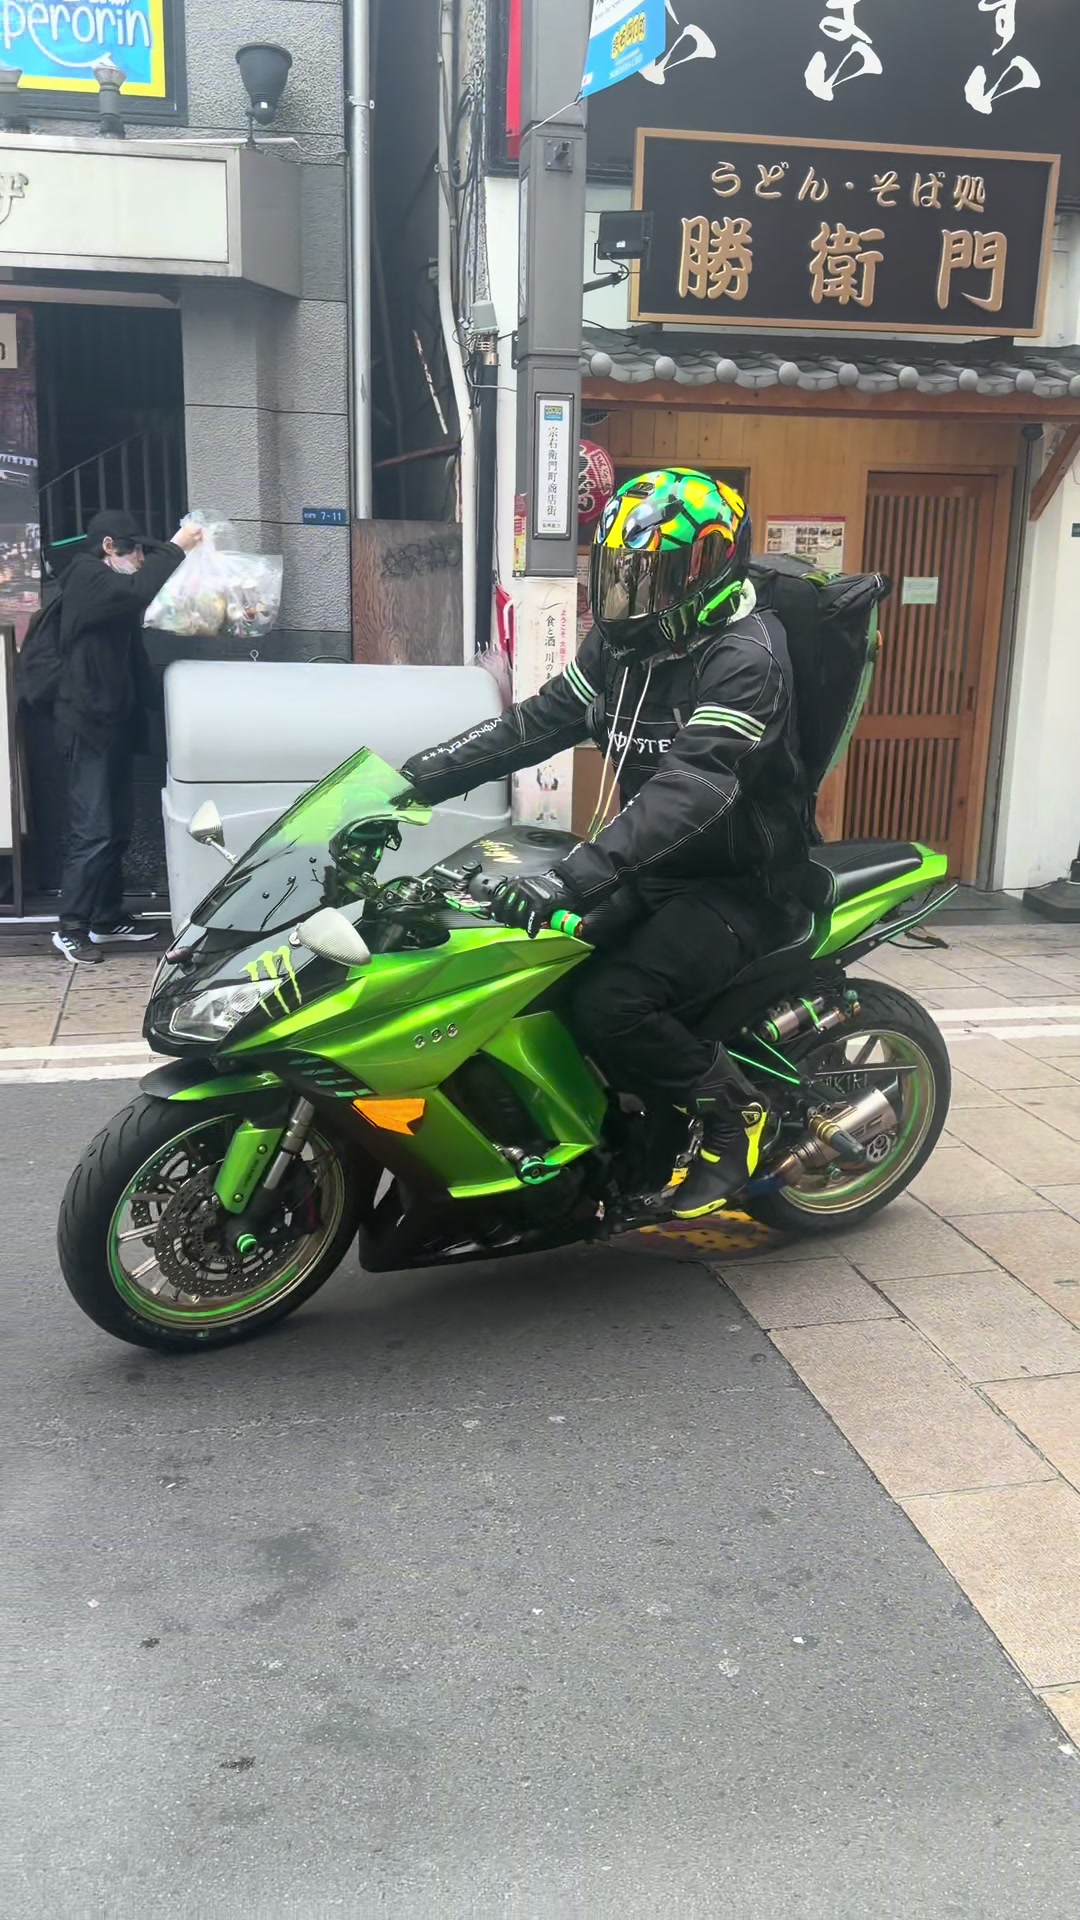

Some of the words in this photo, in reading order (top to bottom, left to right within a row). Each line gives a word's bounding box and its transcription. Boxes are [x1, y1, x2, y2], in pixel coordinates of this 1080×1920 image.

[711, 160, 986, 213] うどん・そば処
[678, 215, 1007, 312] 勝衛門
[320, 511, 342, 522] 7-11
[544, 614, 556, 647] 食と酒
